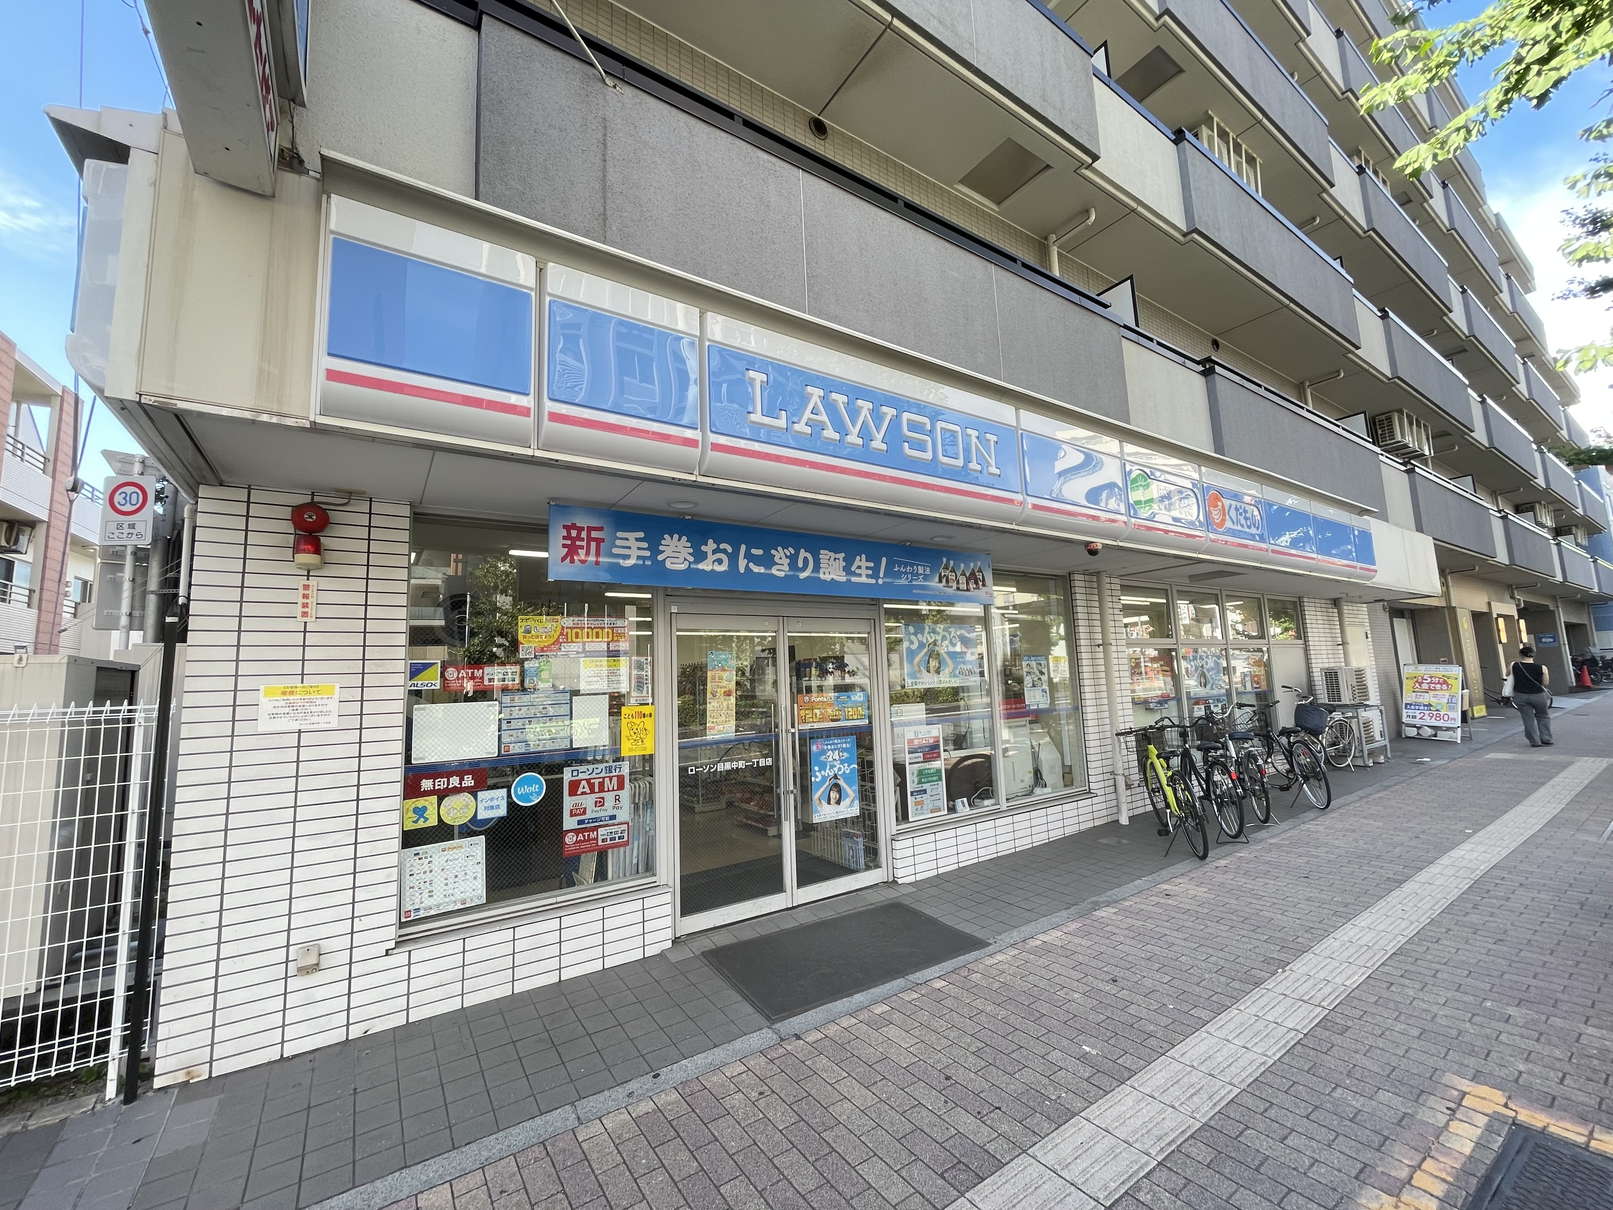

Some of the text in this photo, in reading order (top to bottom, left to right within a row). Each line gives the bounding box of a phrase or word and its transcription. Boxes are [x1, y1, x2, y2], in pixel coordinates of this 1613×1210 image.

[745, 368, 1001, 476] LAWSON
[117, 491, 140, 507] 30
[1227, 503, 1261, 531] くだもの
[107, 531, 144, 540] ここから
[458, 668, 483, 678] ATM
[571, 765, 623, 778] ローソン銀行
[688, 757, 773, 775] ローソン目黒中町一丁目店
[420, 775, 475, 791] 無印良品
[517, 784, 540, 795] Wolt
[578, 778, 617, 794] ATM
[577, 831, 597, 841] ATM
